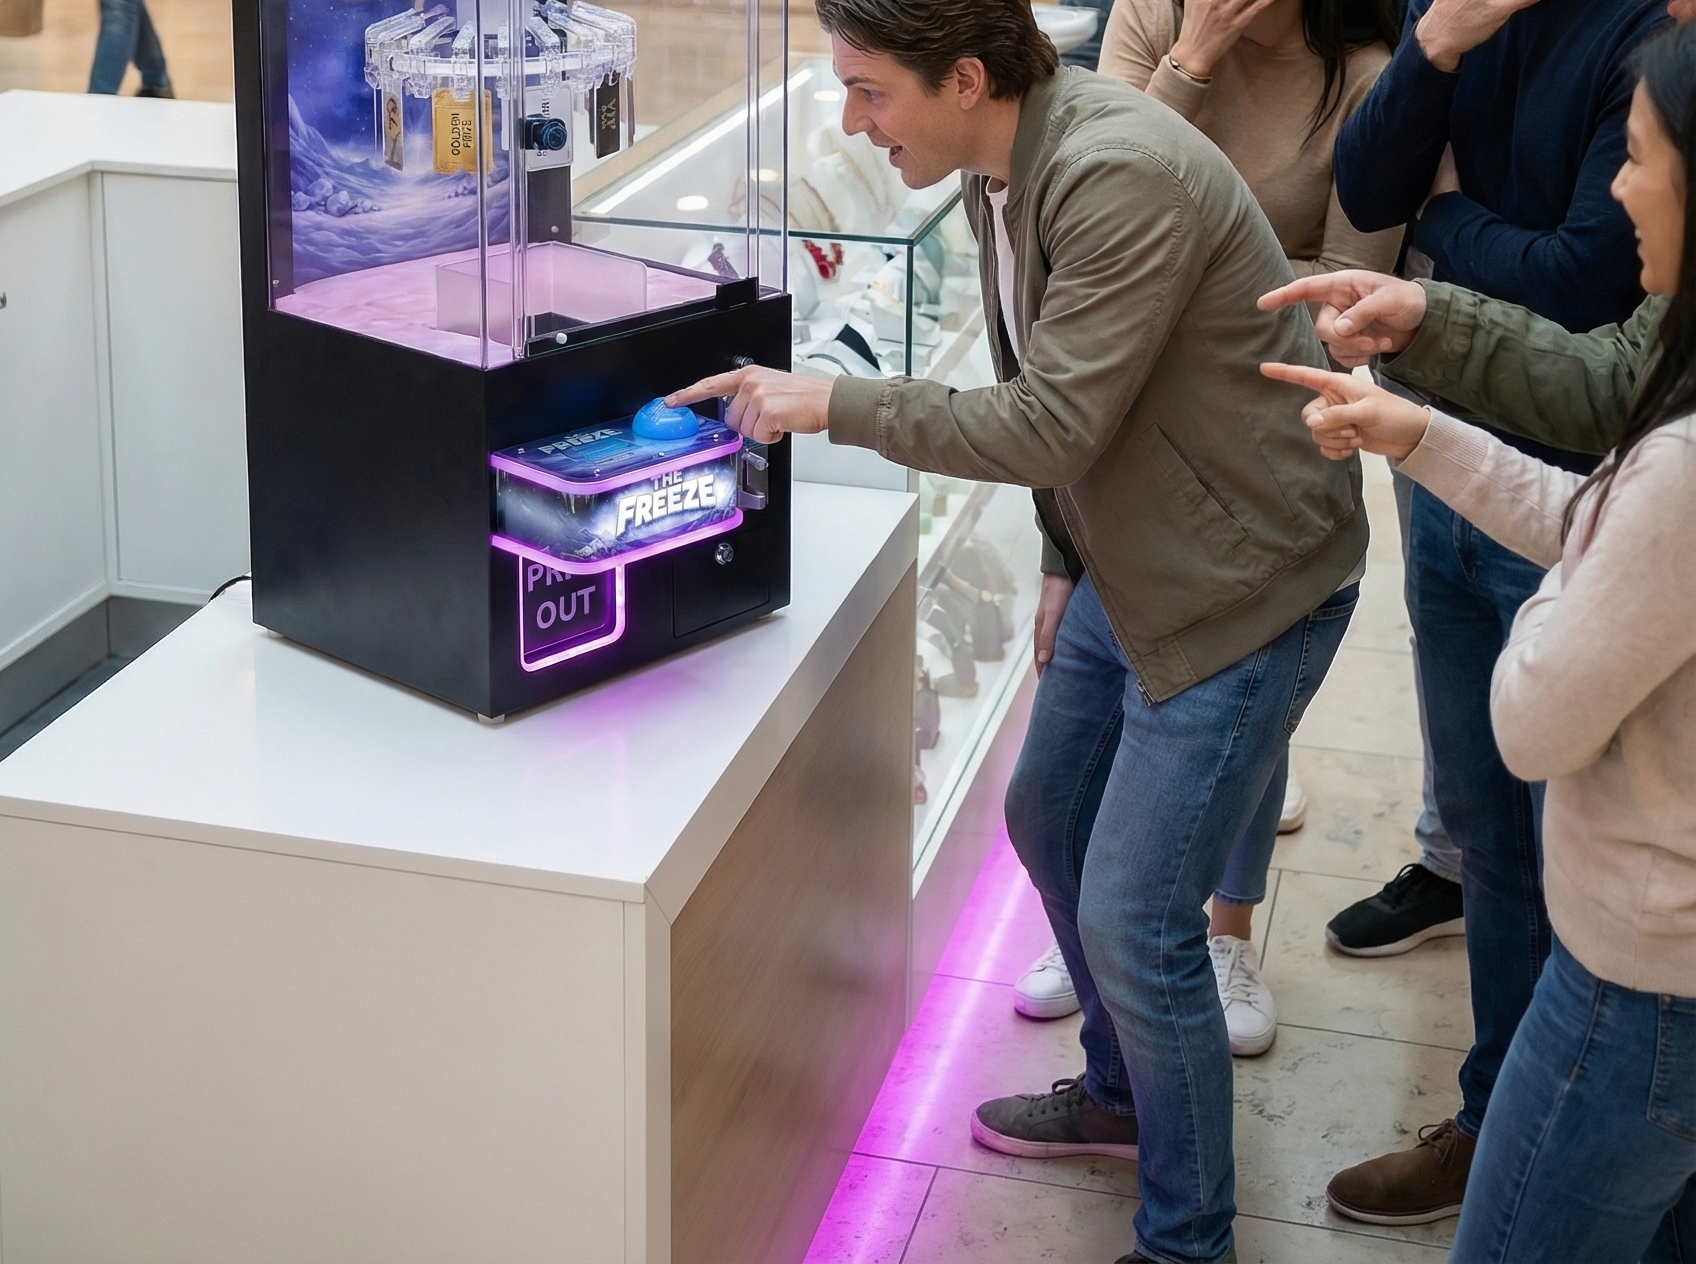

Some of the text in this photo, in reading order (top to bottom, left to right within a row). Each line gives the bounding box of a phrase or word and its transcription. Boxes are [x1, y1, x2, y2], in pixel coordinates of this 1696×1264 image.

[651, 470, 683, 491] THE
[615, 474, 717, 537] FREEZE
[536, 585, 596, 629] OUT
